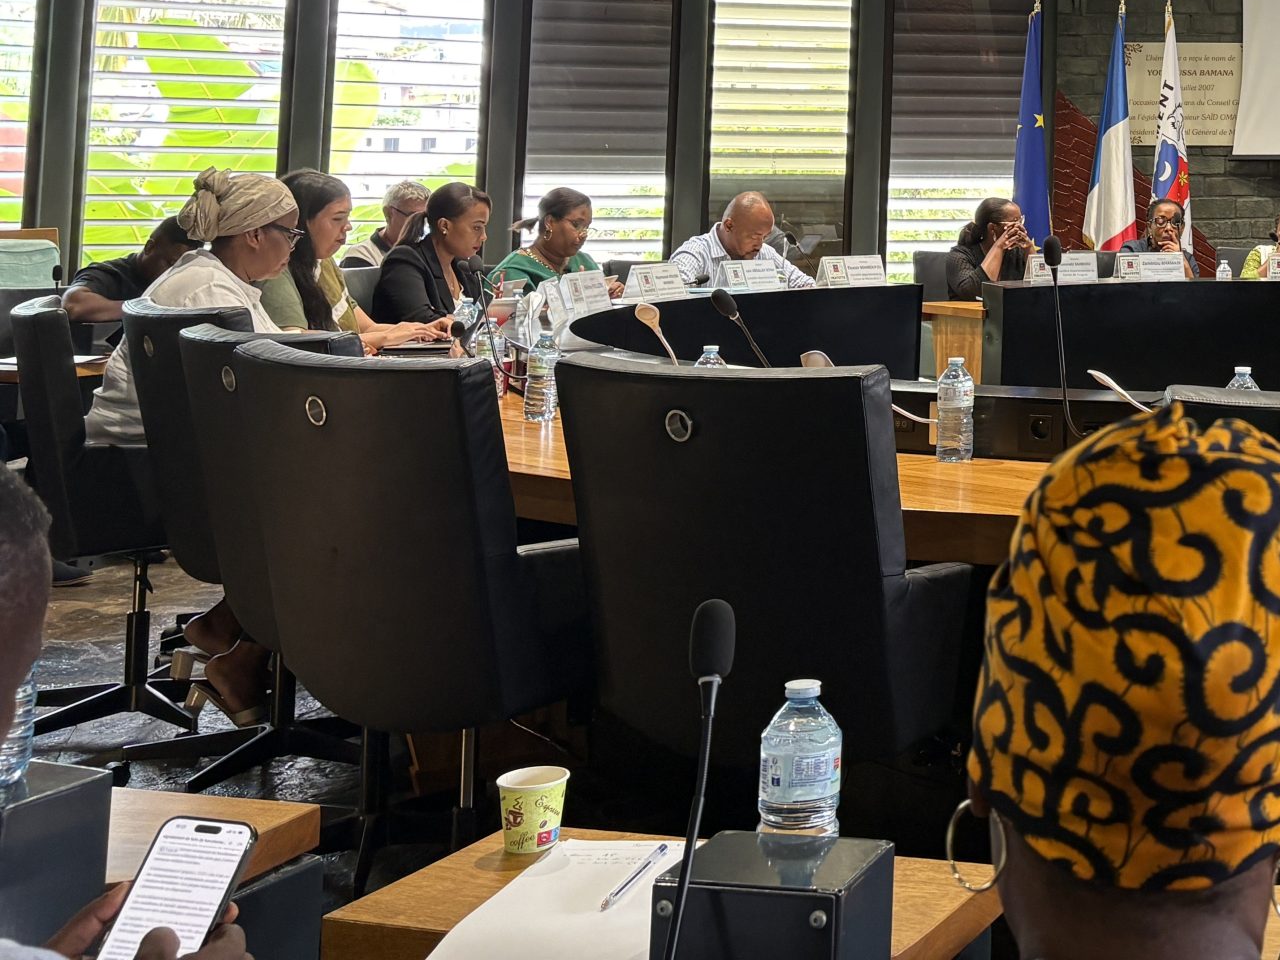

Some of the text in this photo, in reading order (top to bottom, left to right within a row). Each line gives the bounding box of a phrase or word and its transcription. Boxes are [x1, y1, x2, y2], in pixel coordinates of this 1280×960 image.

[1206, 98, 1231, 106] Conseil
[1129, 128, 1155, 136] résident
[1191, 128, 1218, 136] Général
[1219, 128, 1227, 136] de
[510, 831, 535, 851] coffee
